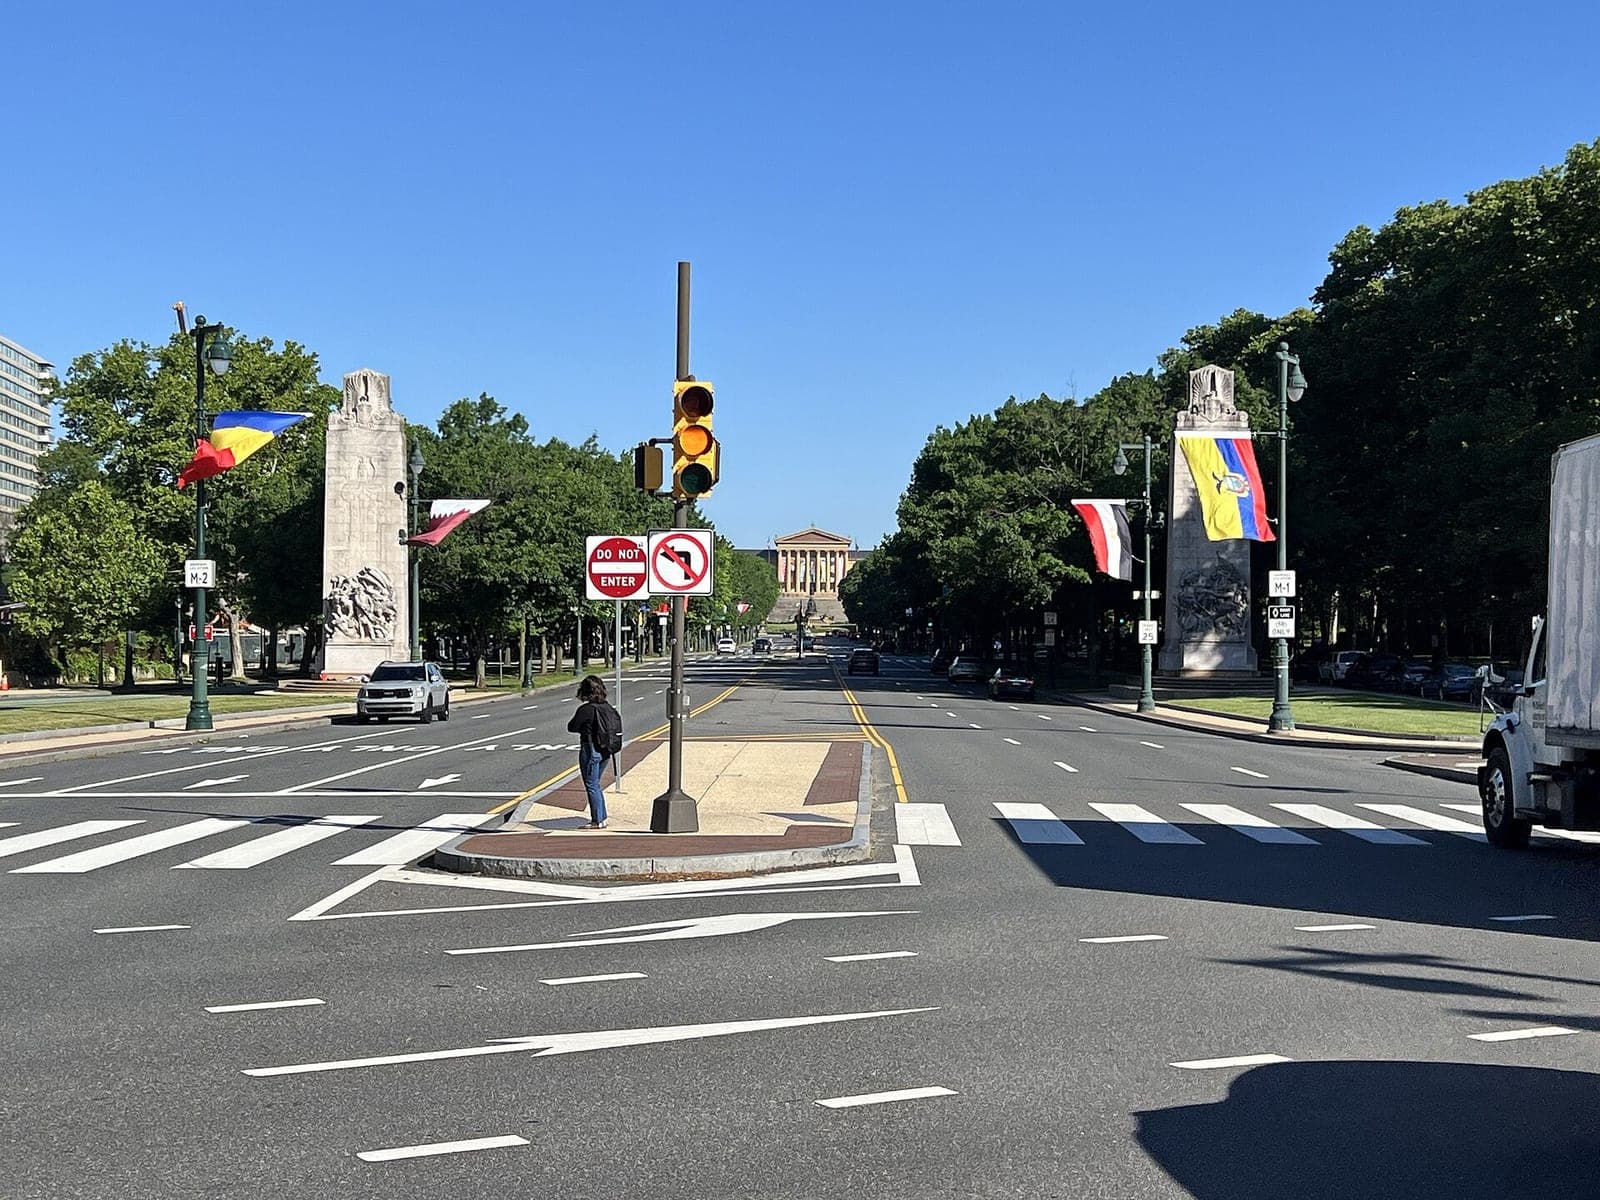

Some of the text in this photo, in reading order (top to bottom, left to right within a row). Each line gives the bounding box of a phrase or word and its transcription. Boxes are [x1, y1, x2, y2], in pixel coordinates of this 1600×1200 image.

[597, 549, 640, 559] DO NOT
[190, 572, 208, 584] M-2
[601, 576, 636, 586] ENTER
[1142, 632, 1154, 640] 25
